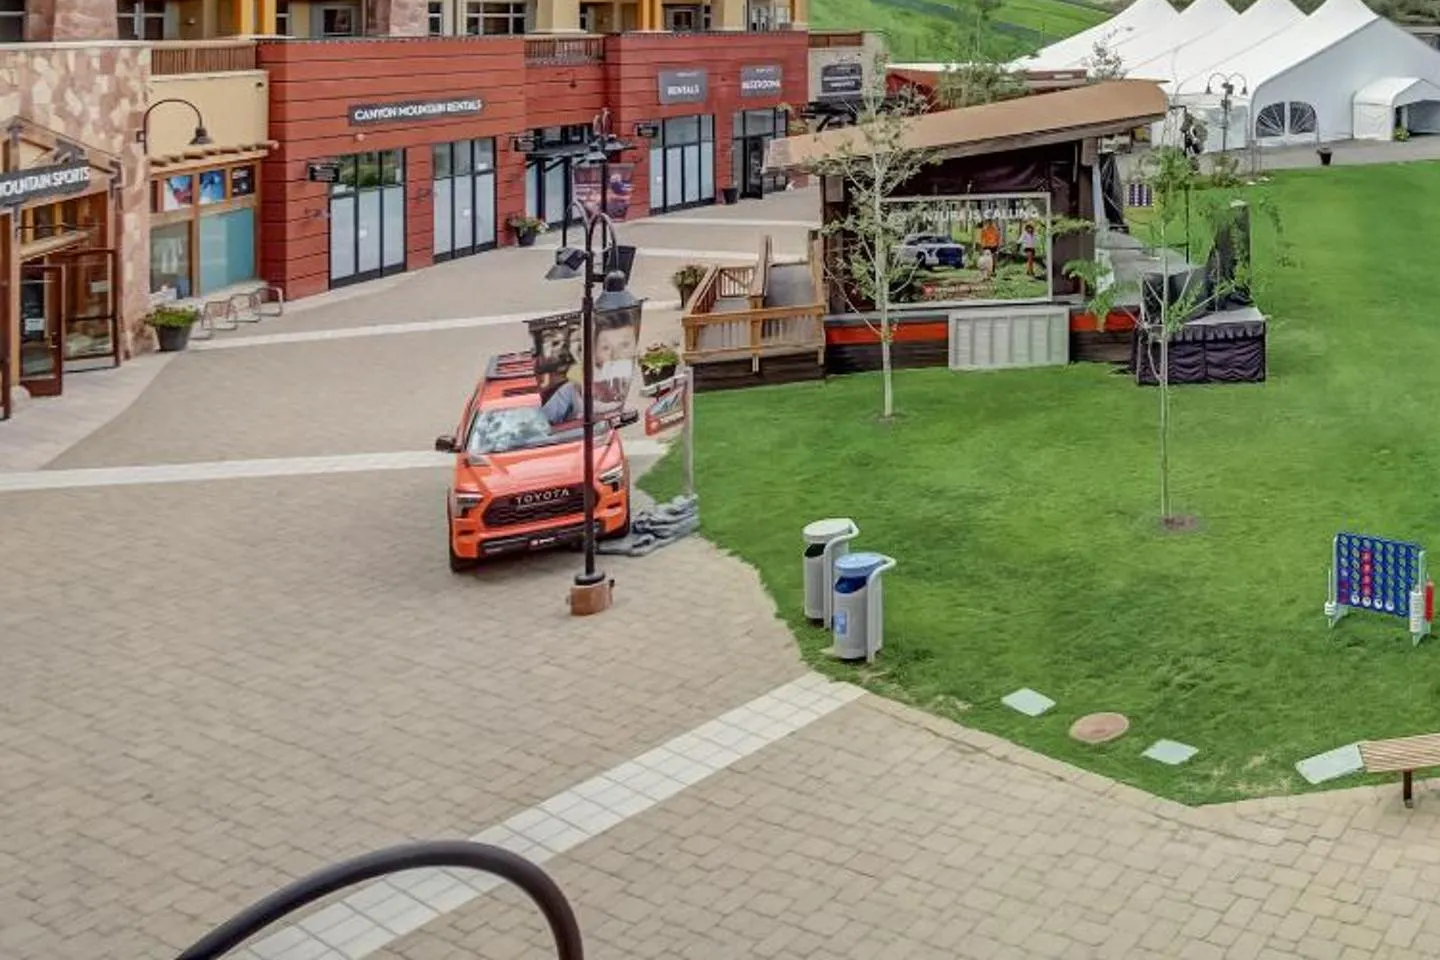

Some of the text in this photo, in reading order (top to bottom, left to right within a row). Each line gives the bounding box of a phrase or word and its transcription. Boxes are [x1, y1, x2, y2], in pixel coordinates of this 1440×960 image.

[354, 99, 482, 120] CANYON MOUNTAIN RENTALS
[52, 167, 90, 186] SPORTS
[516, 488, 569, 504] TOYOTA
